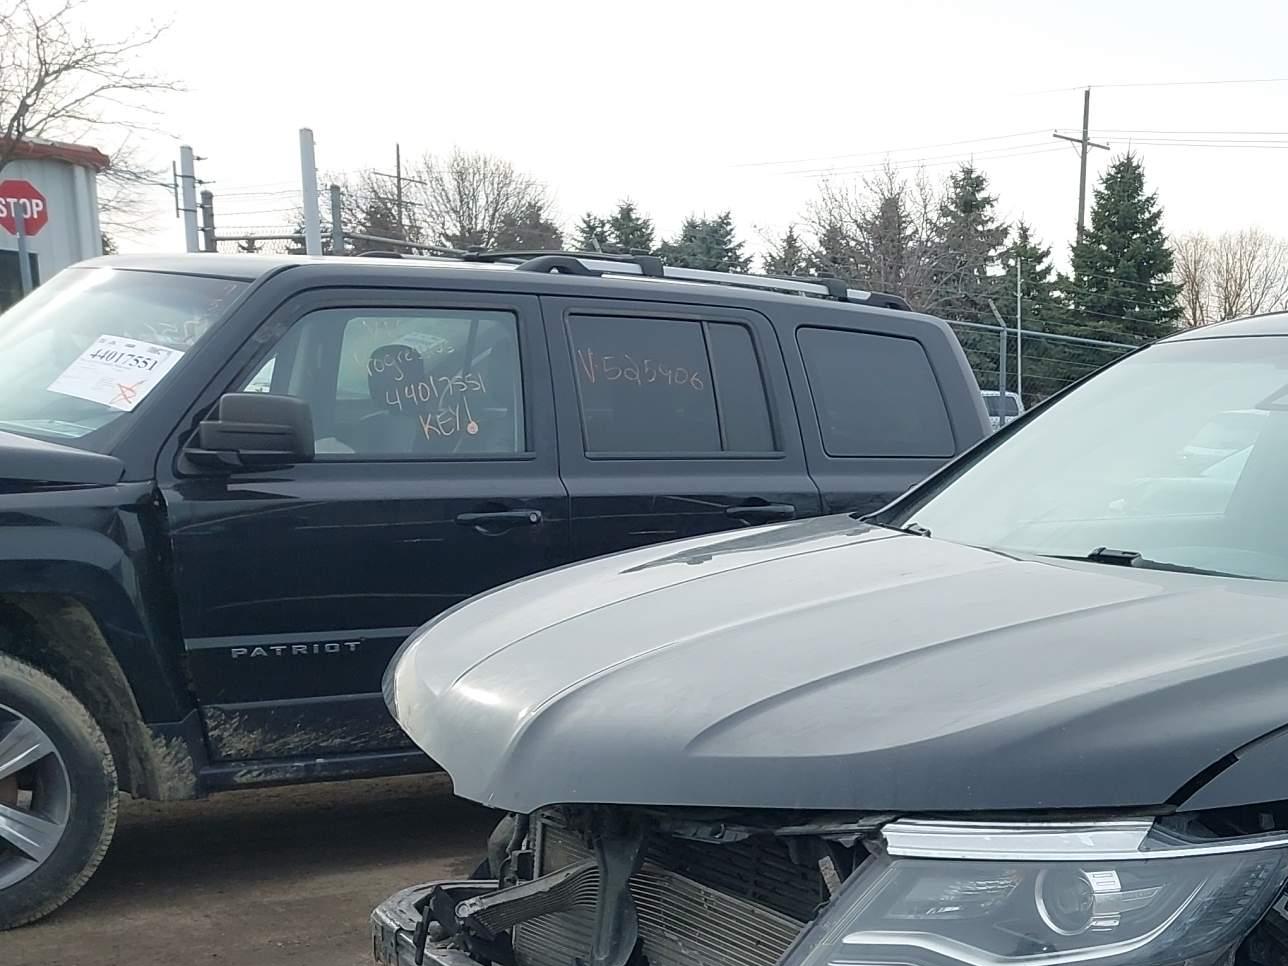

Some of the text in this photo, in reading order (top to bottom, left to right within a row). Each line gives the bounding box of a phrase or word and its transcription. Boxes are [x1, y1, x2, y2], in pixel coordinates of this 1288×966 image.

[0, 197, 43, 219] STOP
[90, 348, 158, 371] 44017551
[386, 373, 487, 411] 44017551
[231, 641, 361, 658] PATRIOT
